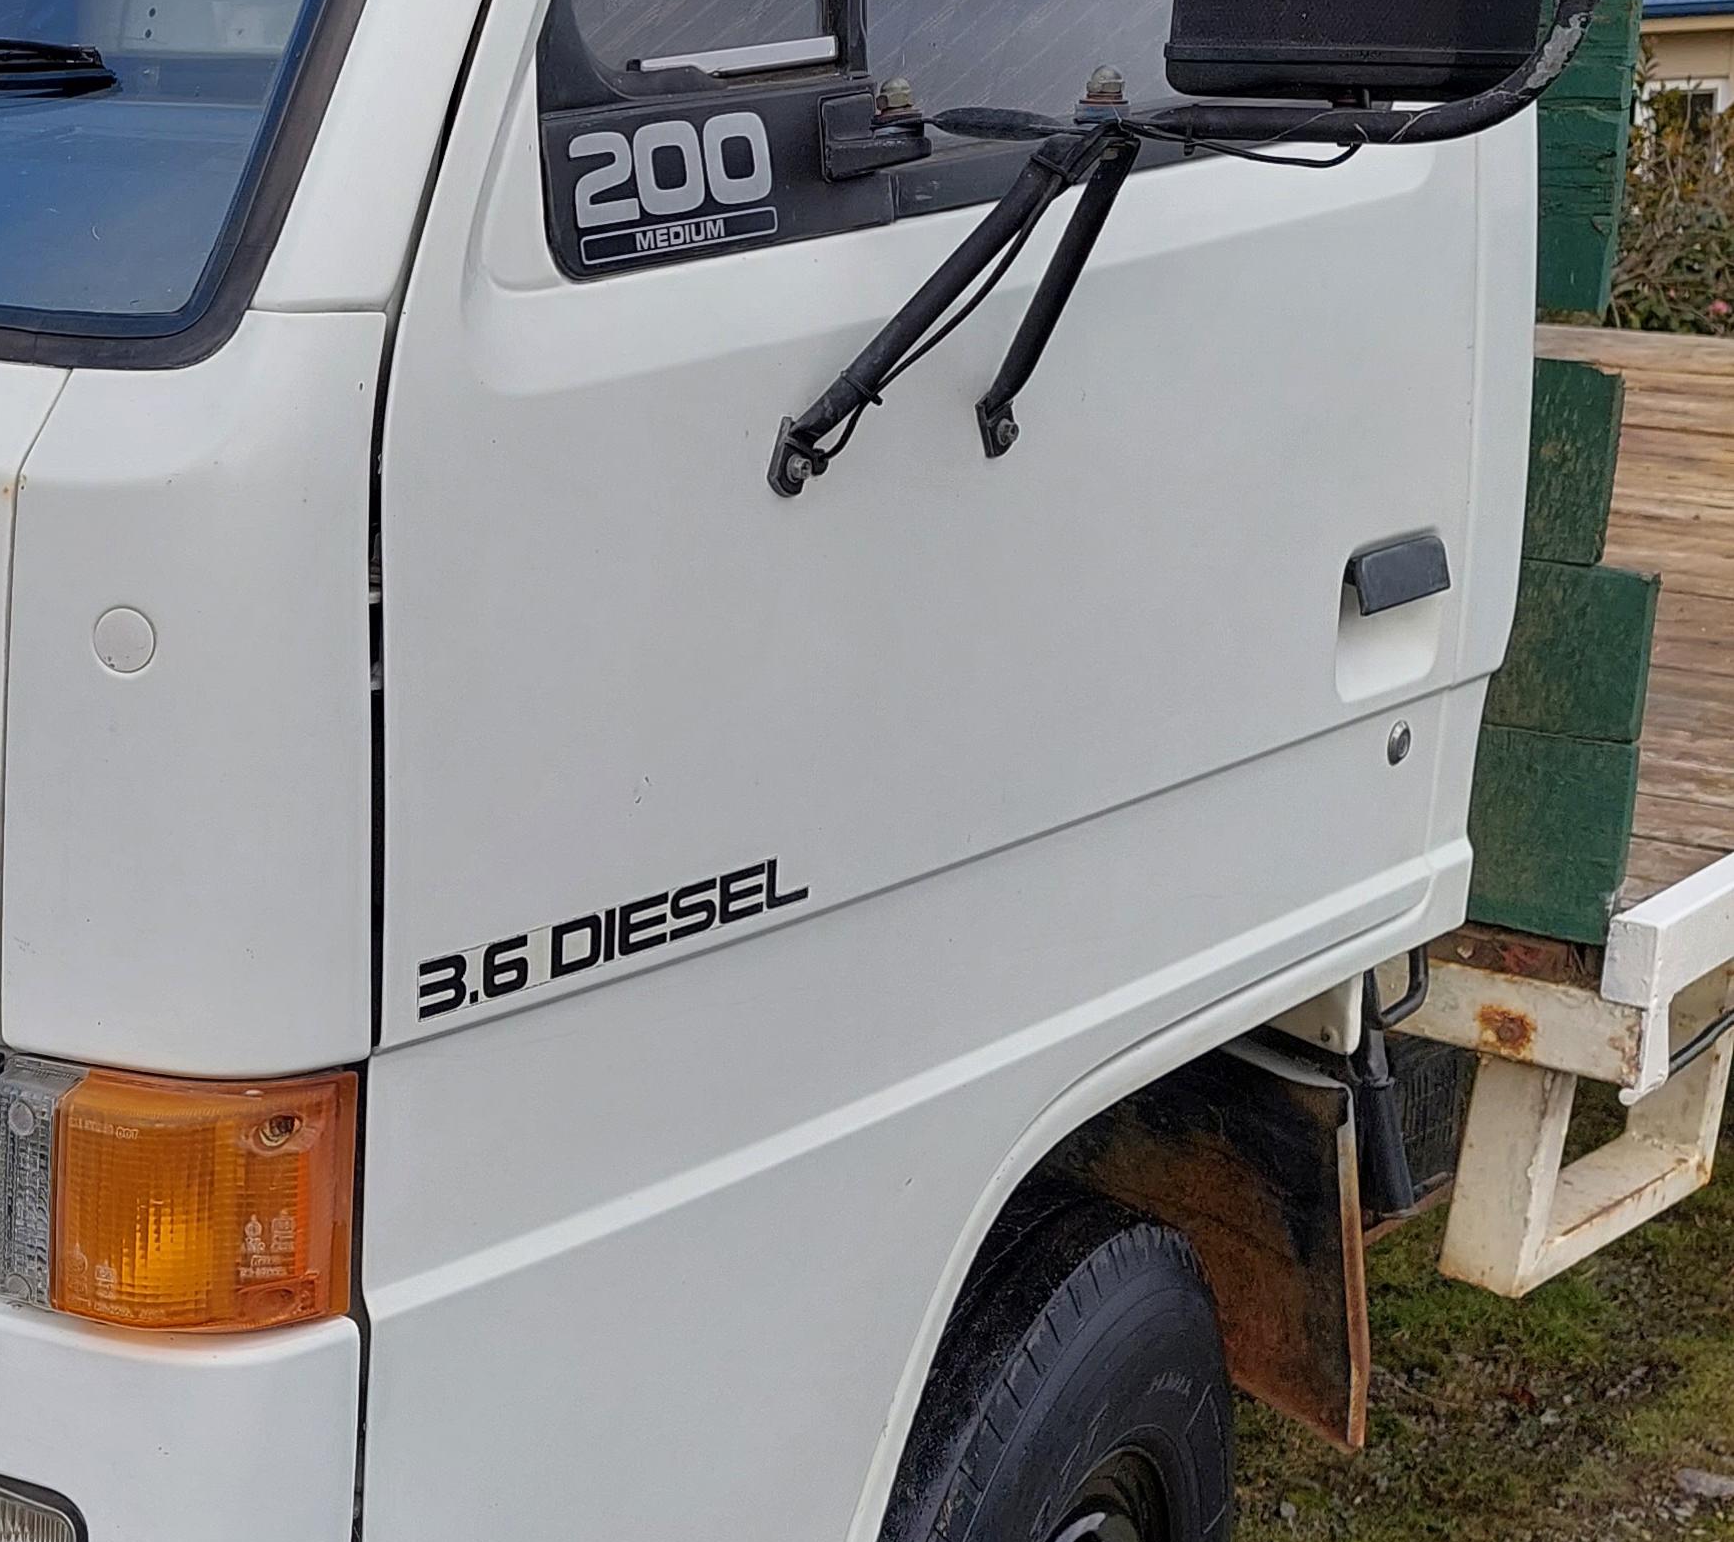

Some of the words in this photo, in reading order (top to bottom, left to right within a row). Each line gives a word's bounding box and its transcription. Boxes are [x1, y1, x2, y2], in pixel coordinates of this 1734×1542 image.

[569, 112, 772, 228] 200
[635, 219, 726, 251] MEDIUM
[419, 934, 529, 1020] 3.6
[550, 858, 810, 979] DIESEL
